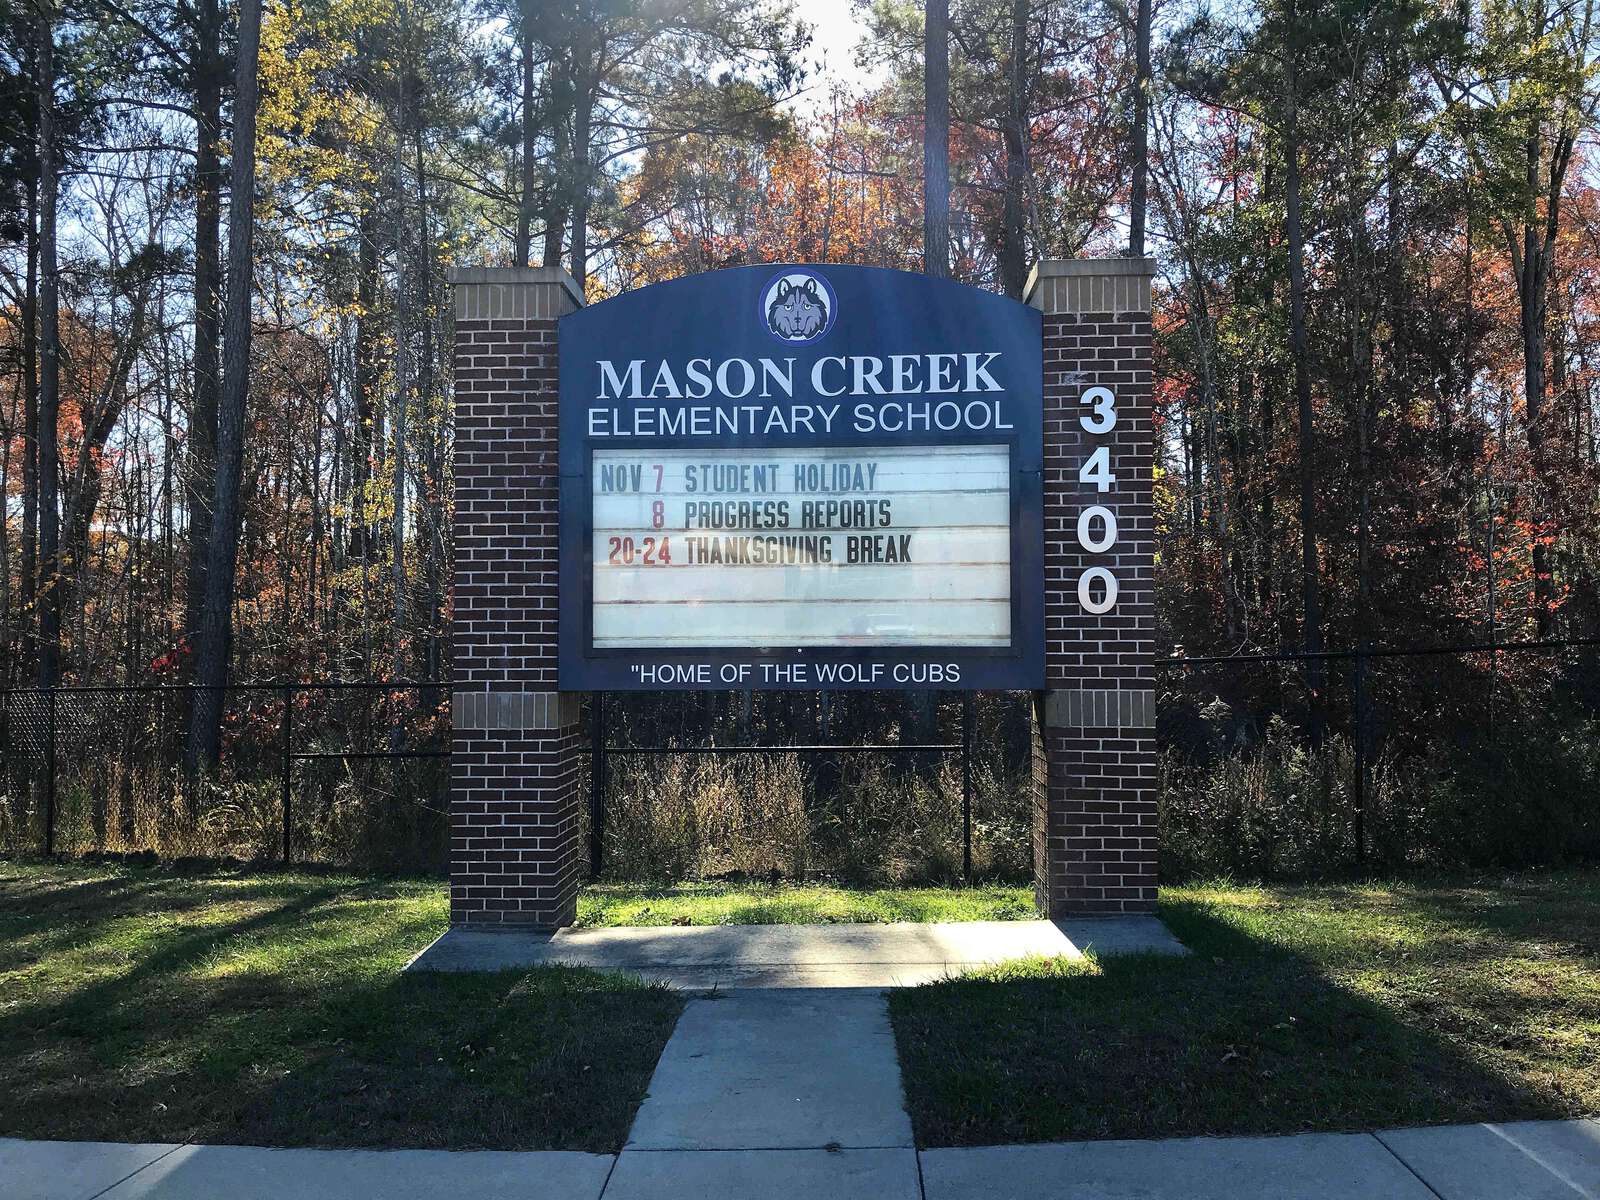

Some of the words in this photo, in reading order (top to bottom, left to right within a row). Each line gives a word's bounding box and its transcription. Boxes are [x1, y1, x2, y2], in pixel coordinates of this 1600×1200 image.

[596, 357, 797, 399] MASON
[810, 351, 1005, 397] CREEK
[588, 404, 841, 436] ELEMENTARY
[853, 400, 1014, 433] SCHOOL
[601, 464, 642, 494] NOV
[653, 465, 664, 493] 7
[685, 463, 778, 493] STUDENT
[794, 463, 878, 492] HOLIDAY
[652, 500, 665, 528] 8
[685, 500, 790, 529] PROGRESS
[801, 499, 892, 528] REPORTS
[1077, 386, 1118, 615] 3400
[608, 536, 672, 565] 20-24
[685, 535, 832, 564] THANKSGIVING
[847, 535, 912, 563] BREAK
[631, 664, 711, 684] "HOME
[720, 664, 751, 684] OF
[759, 664, 807, 684] THE
[815, 663, 885, 683] WOLF
[893, 663, 961, 683] CUBS
